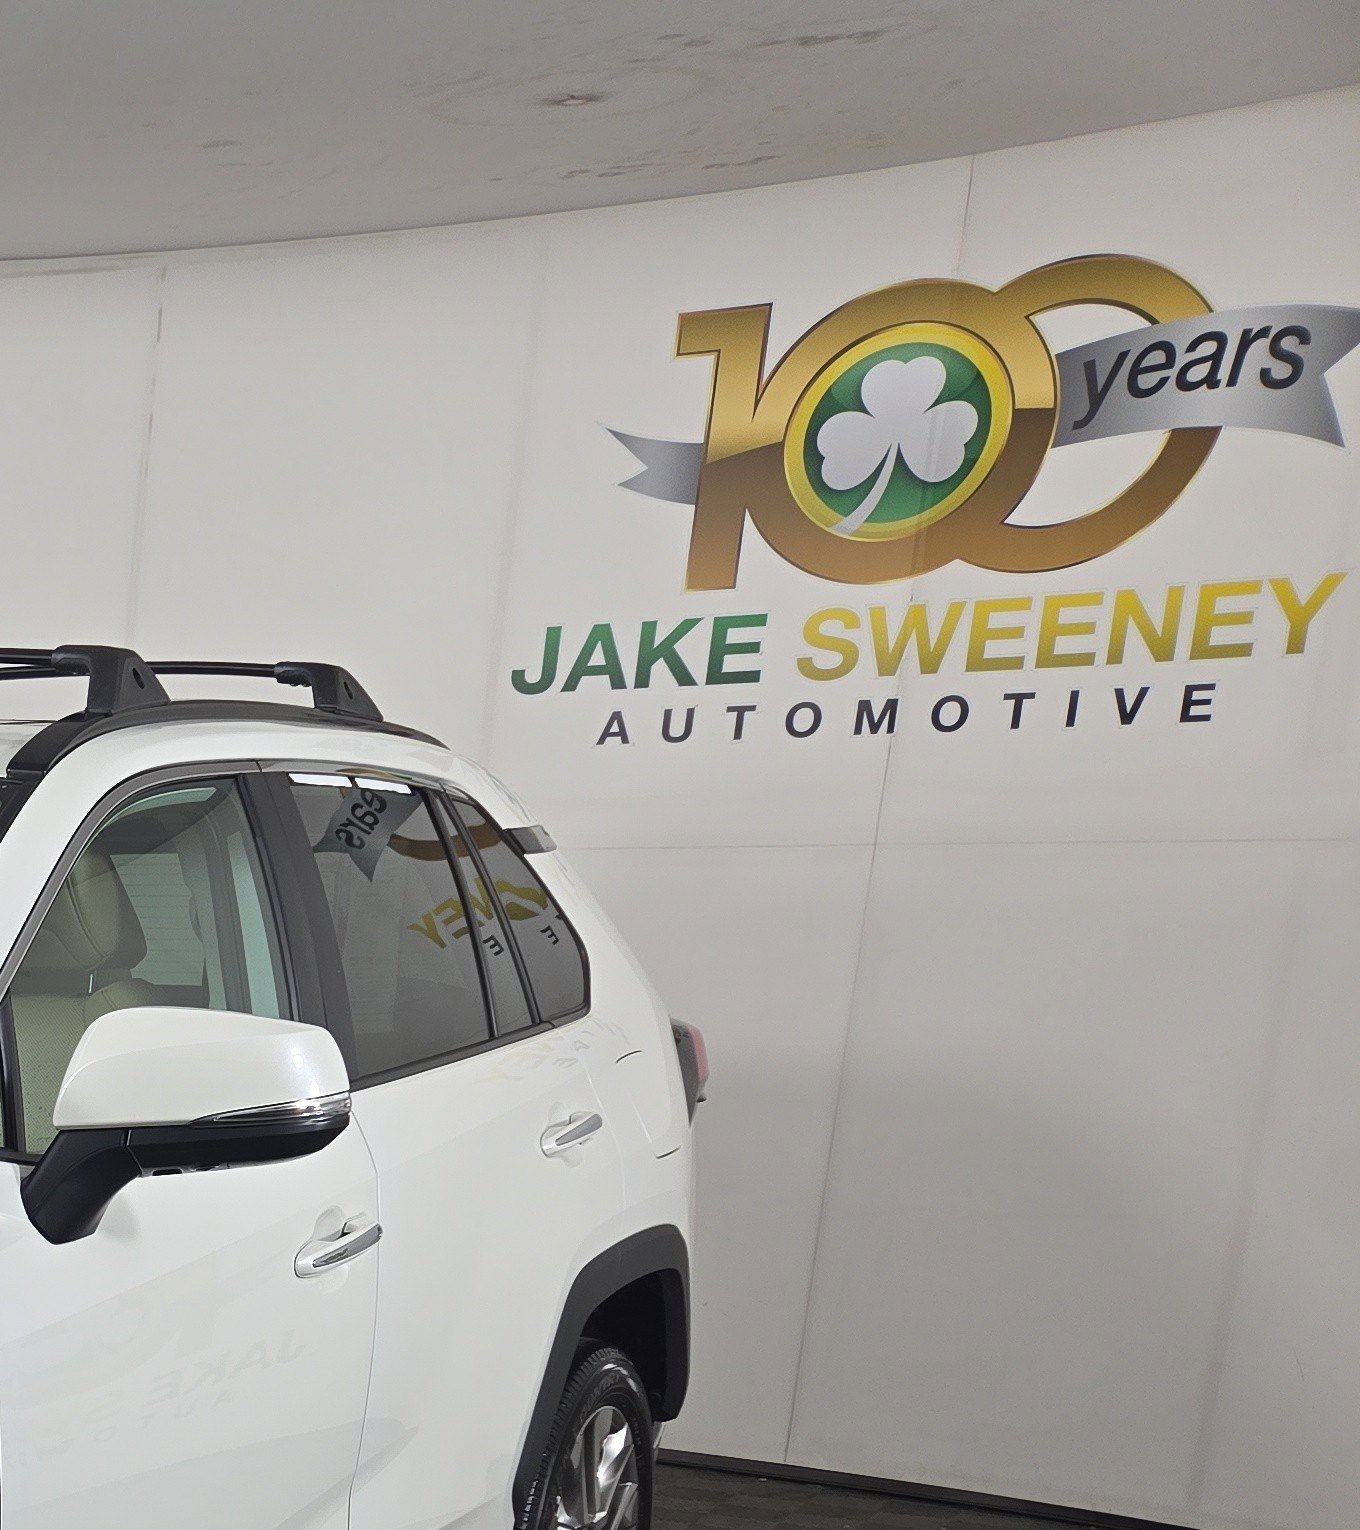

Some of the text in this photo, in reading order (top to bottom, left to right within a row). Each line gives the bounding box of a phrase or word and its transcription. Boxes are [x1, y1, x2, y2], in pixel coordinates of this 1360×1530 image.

[676, 254, 1222, 591] 100
[1073, 323, 1312, 430] years
[511, 573, 1348, 696] JAKE SWEENEY
[596, 683, 1217, 746] AUTOMOTIVE
